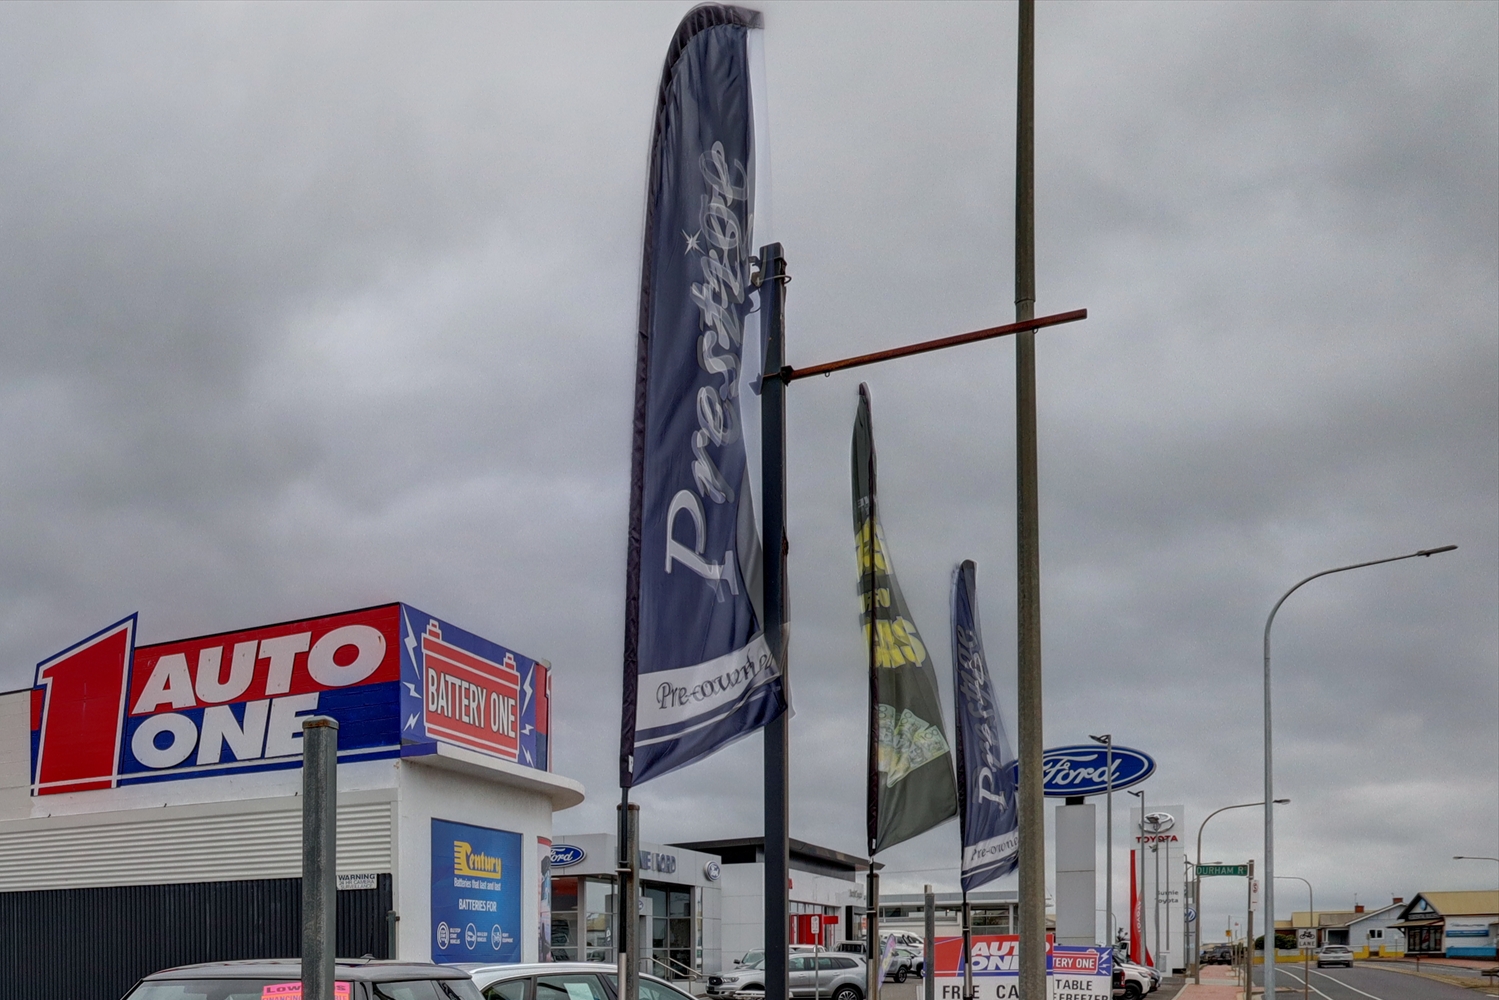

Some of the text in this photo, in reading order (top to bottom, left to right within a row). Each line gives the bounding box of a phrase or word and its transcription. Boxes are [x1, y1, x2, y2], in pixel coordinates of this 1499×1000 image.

[131, 624, 387, 715] AUTO
[428, 667, 516, 738] BATTERY ONE
[131, 692, 320, 769] ONE
[1043, 754, 1122, 785] Ford
[1136, 835, 1178, 843] TOYOTA
[454, 841, 502, 879] Century
[338, 873, 375, 881] WARNING
[1196, 866, 1234, 875] DURHAM
[454, 877, 472, 888] Batteries
[479, 880, 487, 889] last
[459, 898, 497, 912] BATTERIES FOR
[1053, 957, 1095, 969] TERY ONE
[266, 985, 301, 994] LOW
[996, 984, 1019, 999] CA
